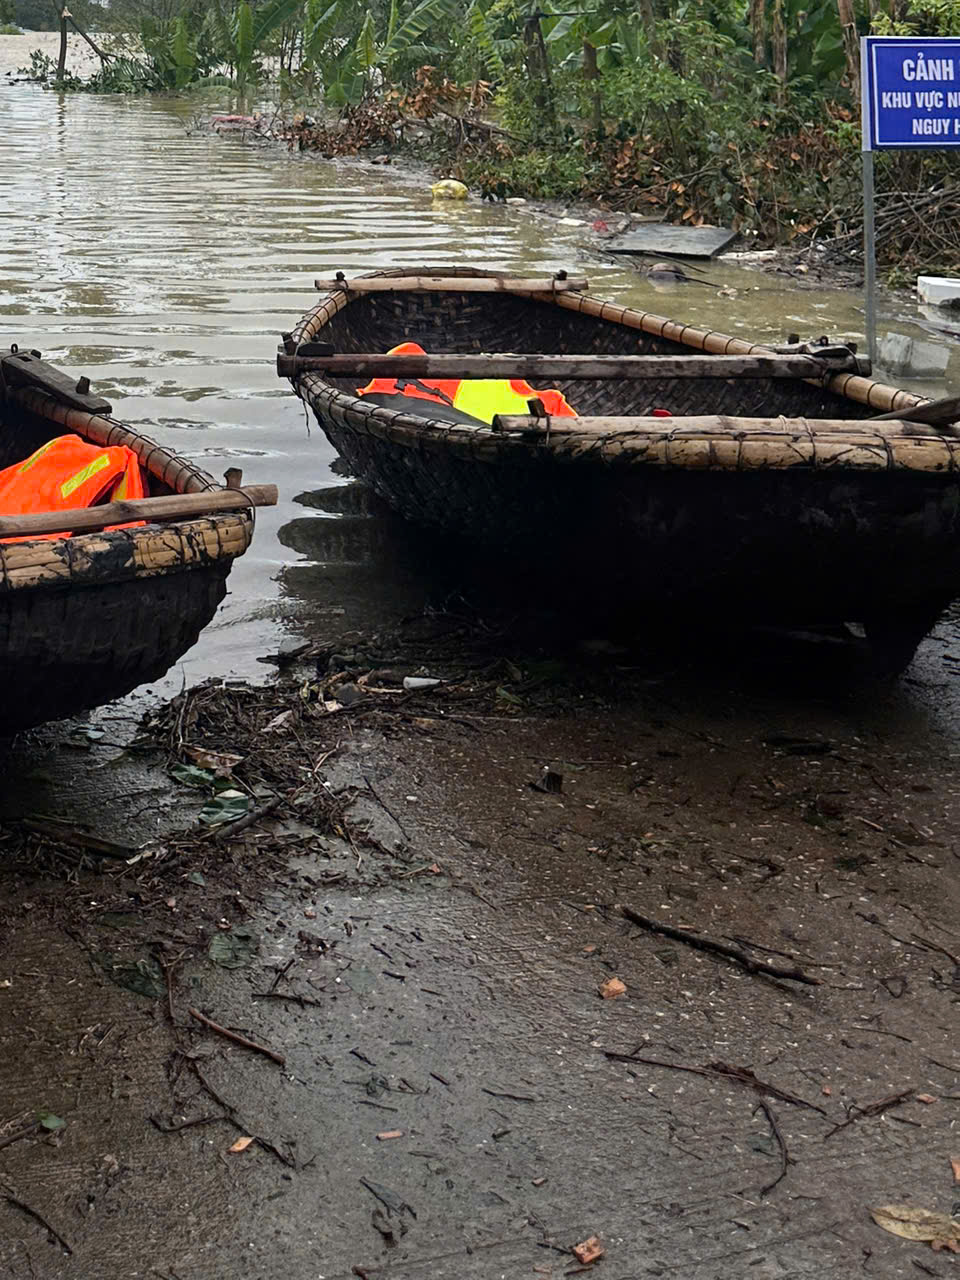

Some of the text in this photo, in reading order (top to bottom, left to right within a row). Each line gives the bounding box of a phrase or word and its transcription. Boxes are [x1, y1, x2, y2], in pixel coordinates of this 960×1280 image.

[902, 52, 954, 81] CẢNH
[881, 92, 911, 108] KHU
[915, 90, 944, 112] VỰC
[912, 118, 950, 135] NGUY
